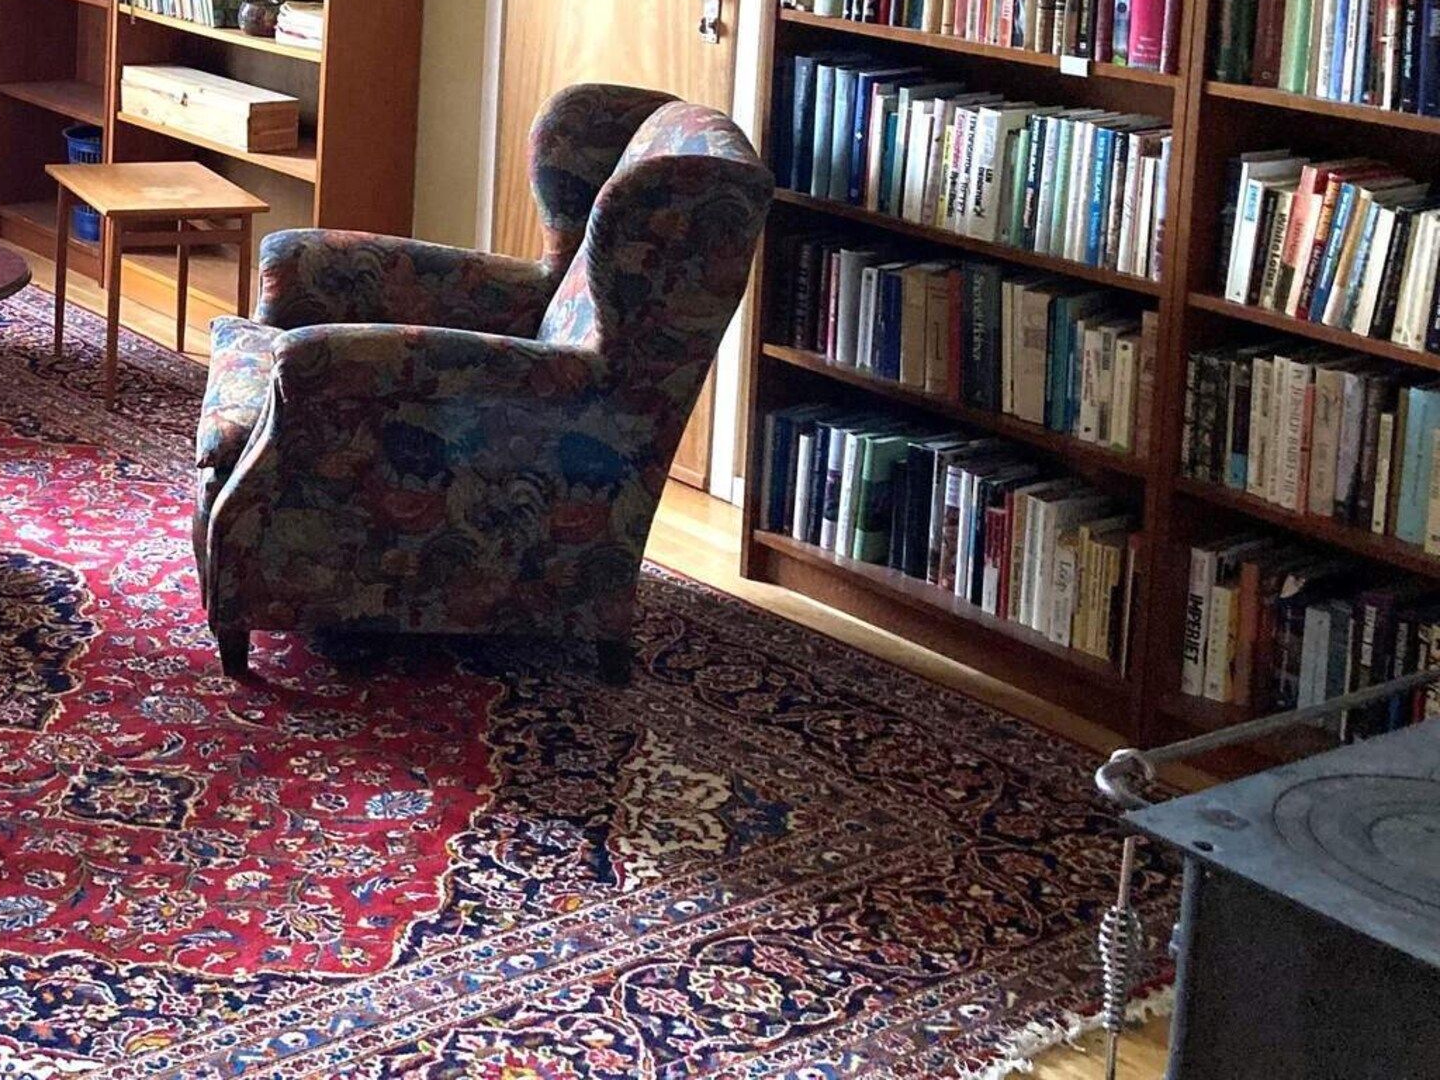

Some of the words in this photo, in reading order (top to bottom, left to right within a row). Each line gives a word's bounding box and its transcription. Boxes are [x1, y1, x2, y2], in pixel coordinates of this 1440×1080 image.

[1271, 213, 1287, 251] White
[1265, 252, 1280, 288] Lotus
[1183, 593, 1204, 664] IMPERIET
